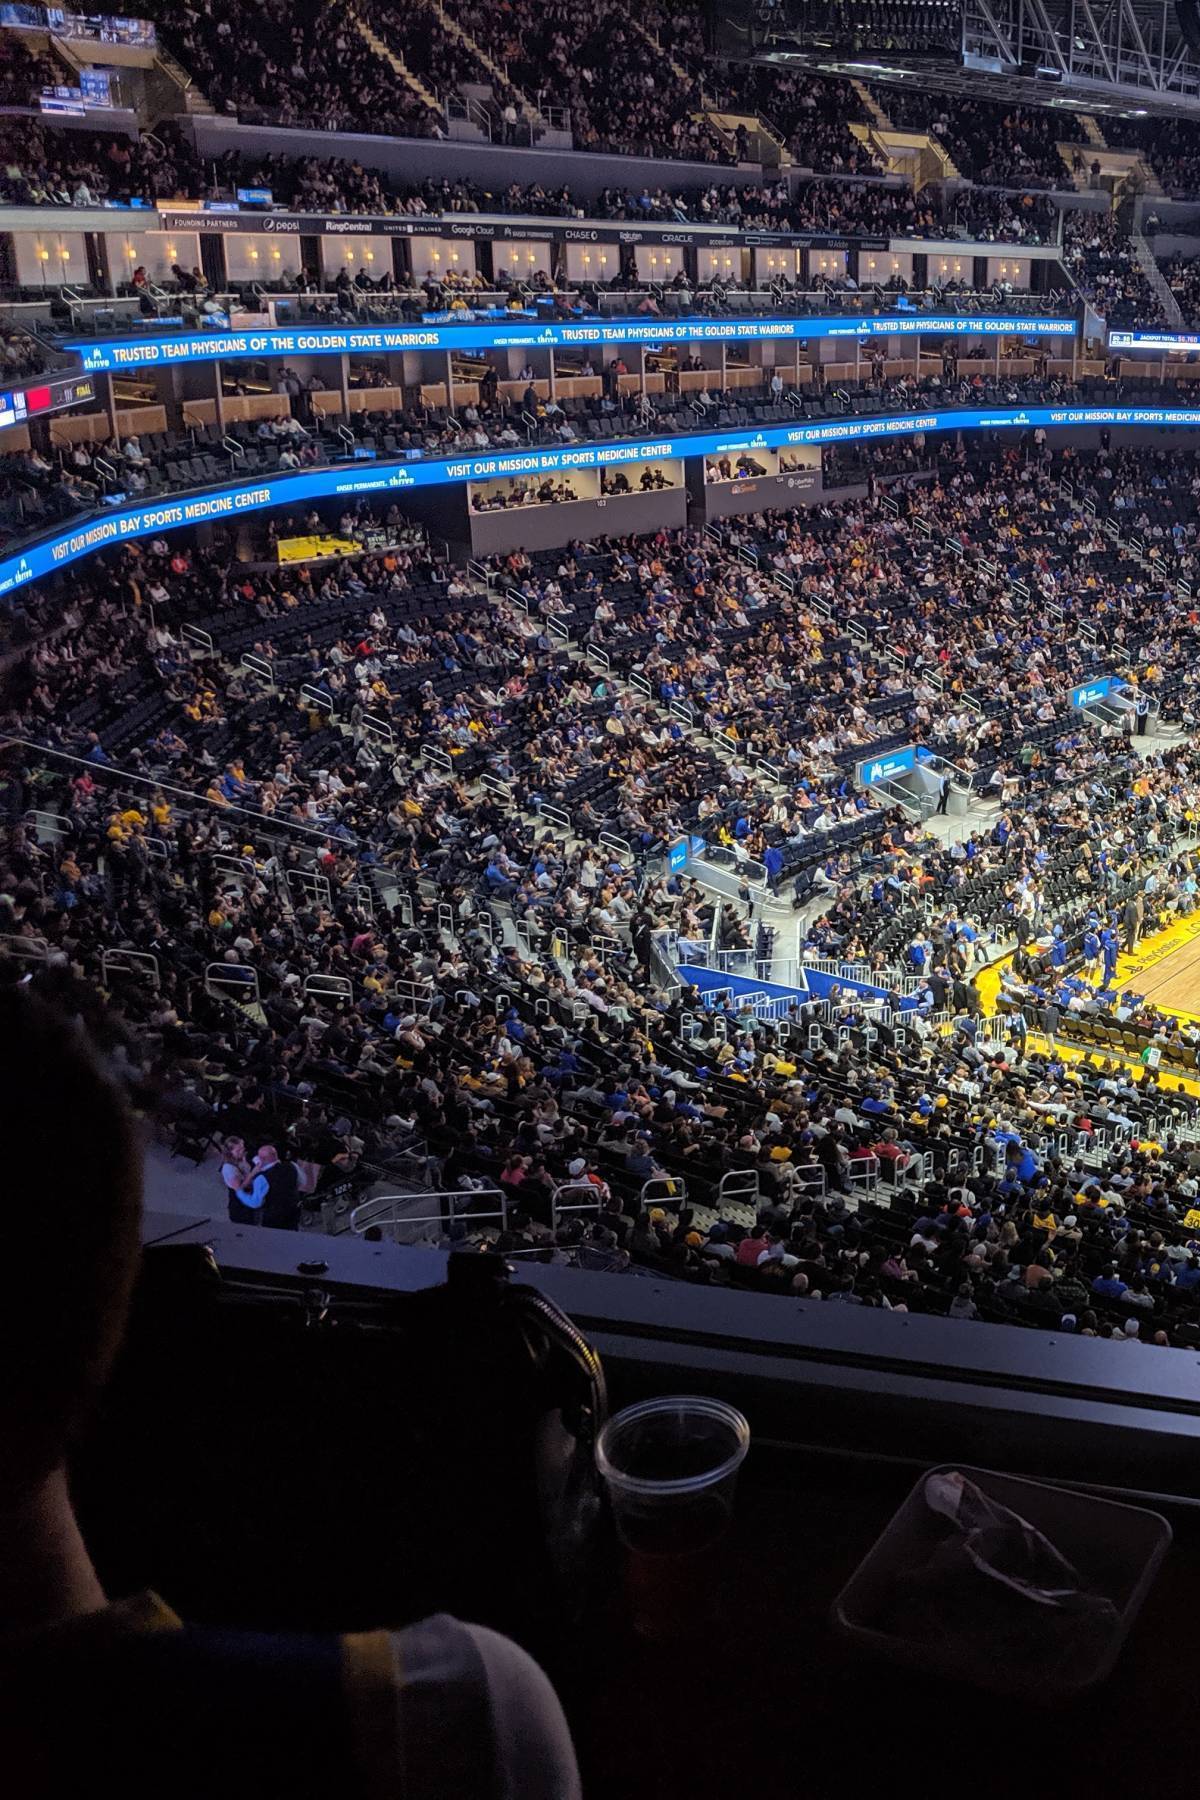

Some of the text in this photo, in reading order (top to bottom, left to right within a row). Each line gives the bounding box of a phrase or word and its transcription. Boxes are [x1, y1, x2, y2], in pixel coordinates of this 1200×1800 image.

[207, 220, 237, 228] PARTNERS
[276, 221, 299, 232] pepsi
[326, 221, 371, 231] RingCentral
[452, 224, 494, 235] Google Cloud
[565, 230, 590, 240] CHASE
[662, 234, 693, 243] ORACLE
[562, 325, 794, 340] TRUSTED TEAM PHYSICIANS OF THE GOLDEN STATE WARRIORS
[113, 333, 439, 362] TRUSTED TEAM PHYSICIANS OF THE GOLDEN STATE WARRIORS
[788, 418, 937, 441] VISIT OUR MISSION BAY SPORTS MEDICINE CENTER
[447, 445, 672, 477] VISIT OUR MISSION BAY SPORTS MEDICINE CENTER
[52, 489, 271, 561] VISIT OUR MISSION BAY SPORTS MEDICINE CENTER
[1137, 938, 1184, 964] PlayStation
